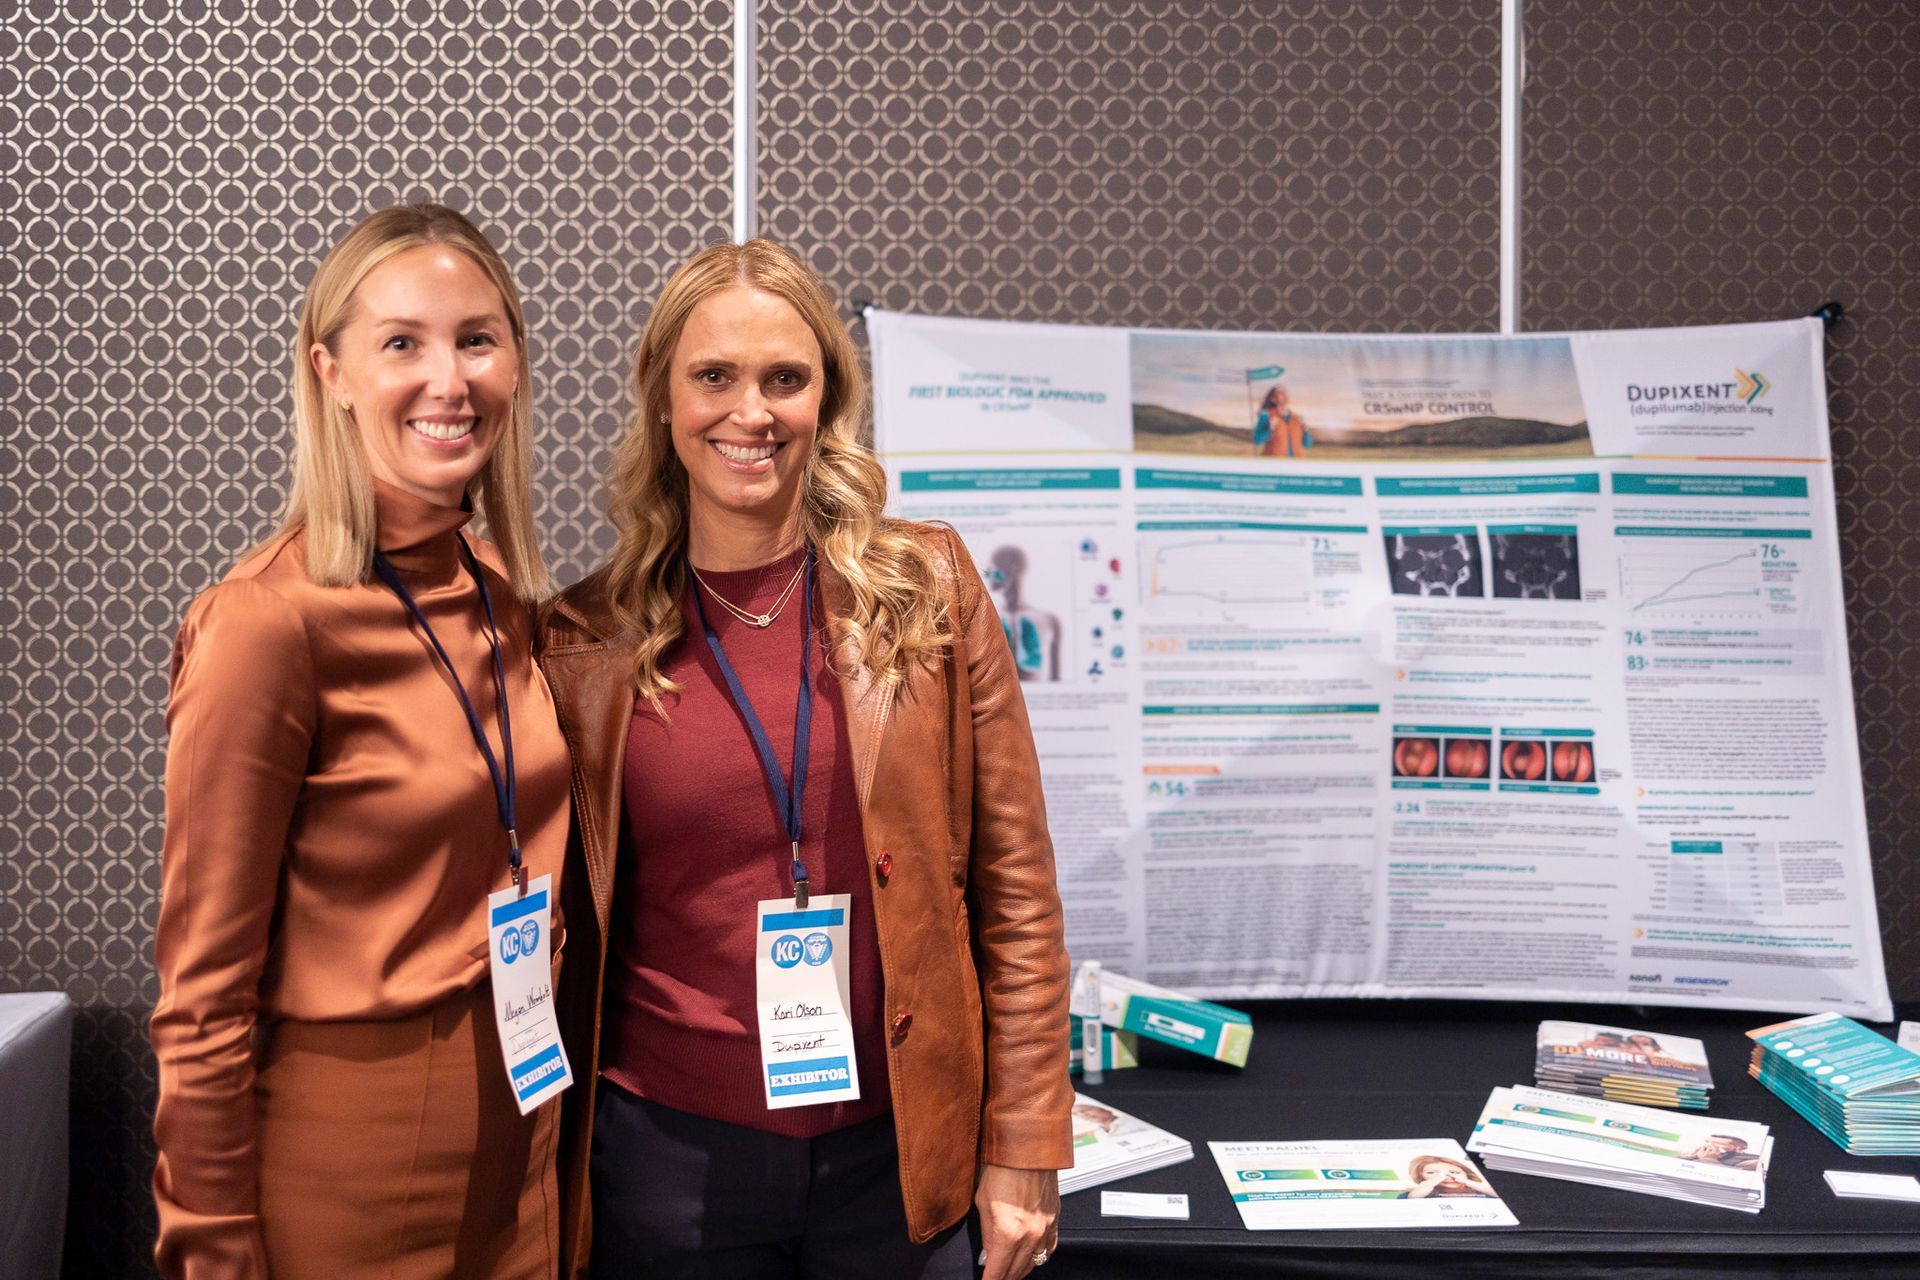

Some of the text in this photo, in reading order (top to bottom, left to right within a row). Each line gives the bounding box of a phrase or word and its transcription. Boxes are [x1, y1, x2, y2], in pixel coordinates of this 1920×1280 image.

[1627, 384, 1736, 401] DUPIXENT
[1362, 401, 1496, 416] CRSwNP CONTROL
[502, 932, 519, 959] KC
[775, 940, 801, 963] KC
[1585, 1048, 1649, 1065] MORE
[515, 1055, 564, 1092] EXHIBITOR
[769, 1067, 849, 1088] EXHIBITOR
